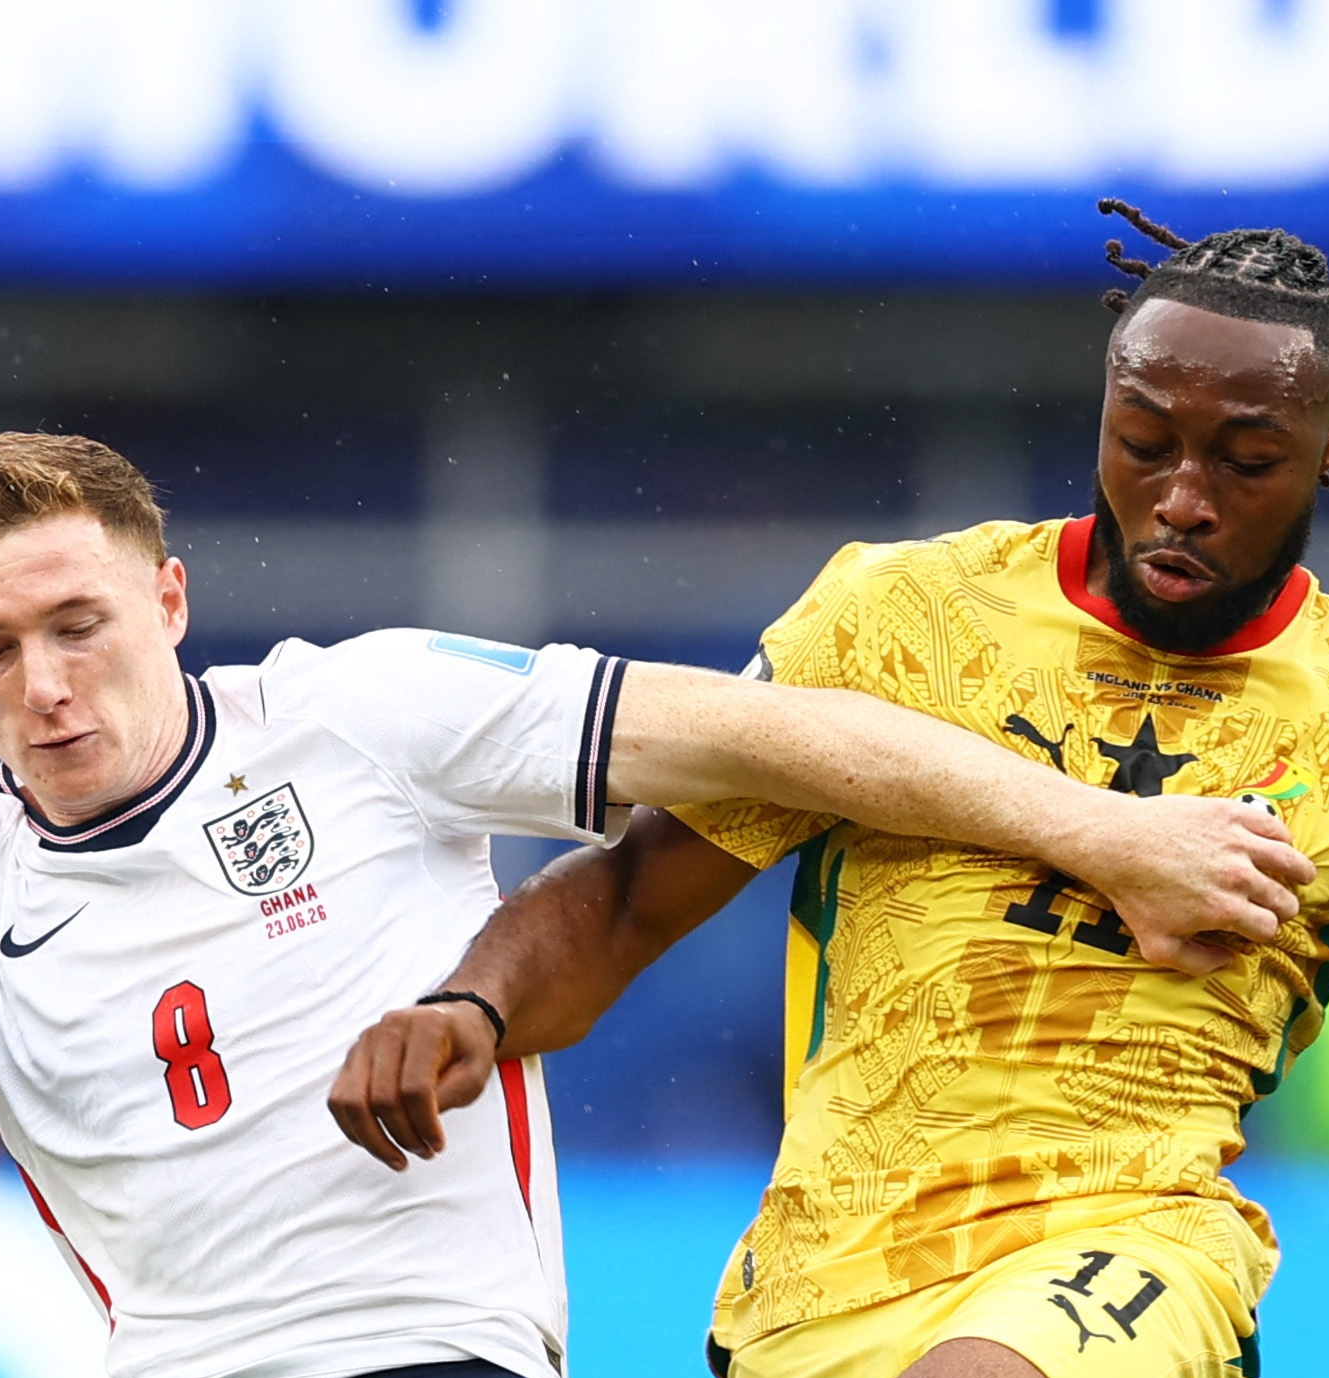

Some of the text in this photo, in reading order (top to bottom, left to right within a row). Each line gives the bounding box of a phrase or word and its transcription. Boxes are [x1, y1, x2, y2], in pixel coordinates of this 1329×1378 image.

[1086, 671, 1151, 691] ENGLAND
[1175, 682, 1224, 702] GHANA
[260, 883, 318, 917] GHANA
[265, 904, 327, 939] 23.06.26
[152, 979, 232, 1131] 8
[1048, 1249, 1168, 1341] 11
